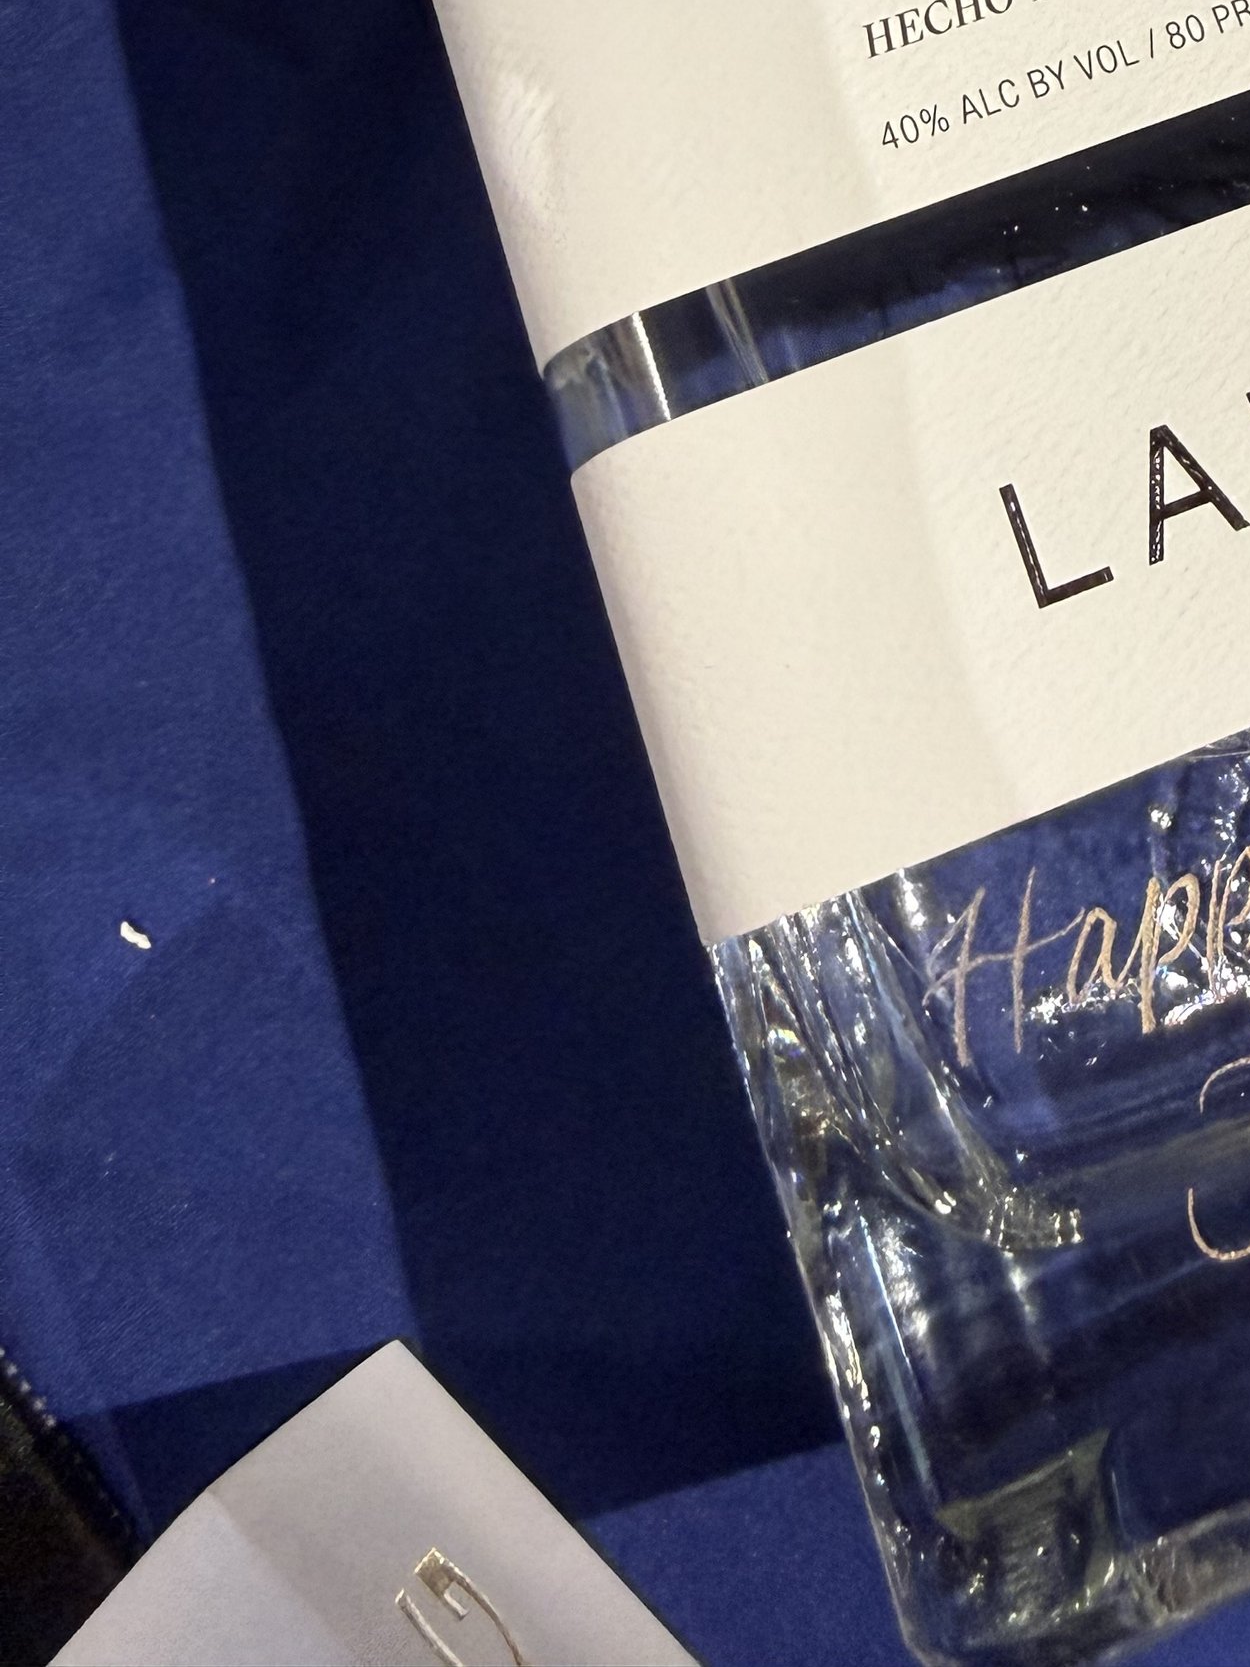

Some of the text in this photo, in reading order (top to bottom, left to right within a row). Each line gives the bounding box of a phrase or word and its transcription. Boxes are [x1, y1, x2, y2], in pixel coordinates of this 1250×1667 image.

[880, 103, 951, 151] 40%
[961, 78, 1021, 126] ALC
[1027, 60, 1067, 101] BY
[1074, 37, 1141, 82] VOL
[1166, 13, 1206, 51] 80
